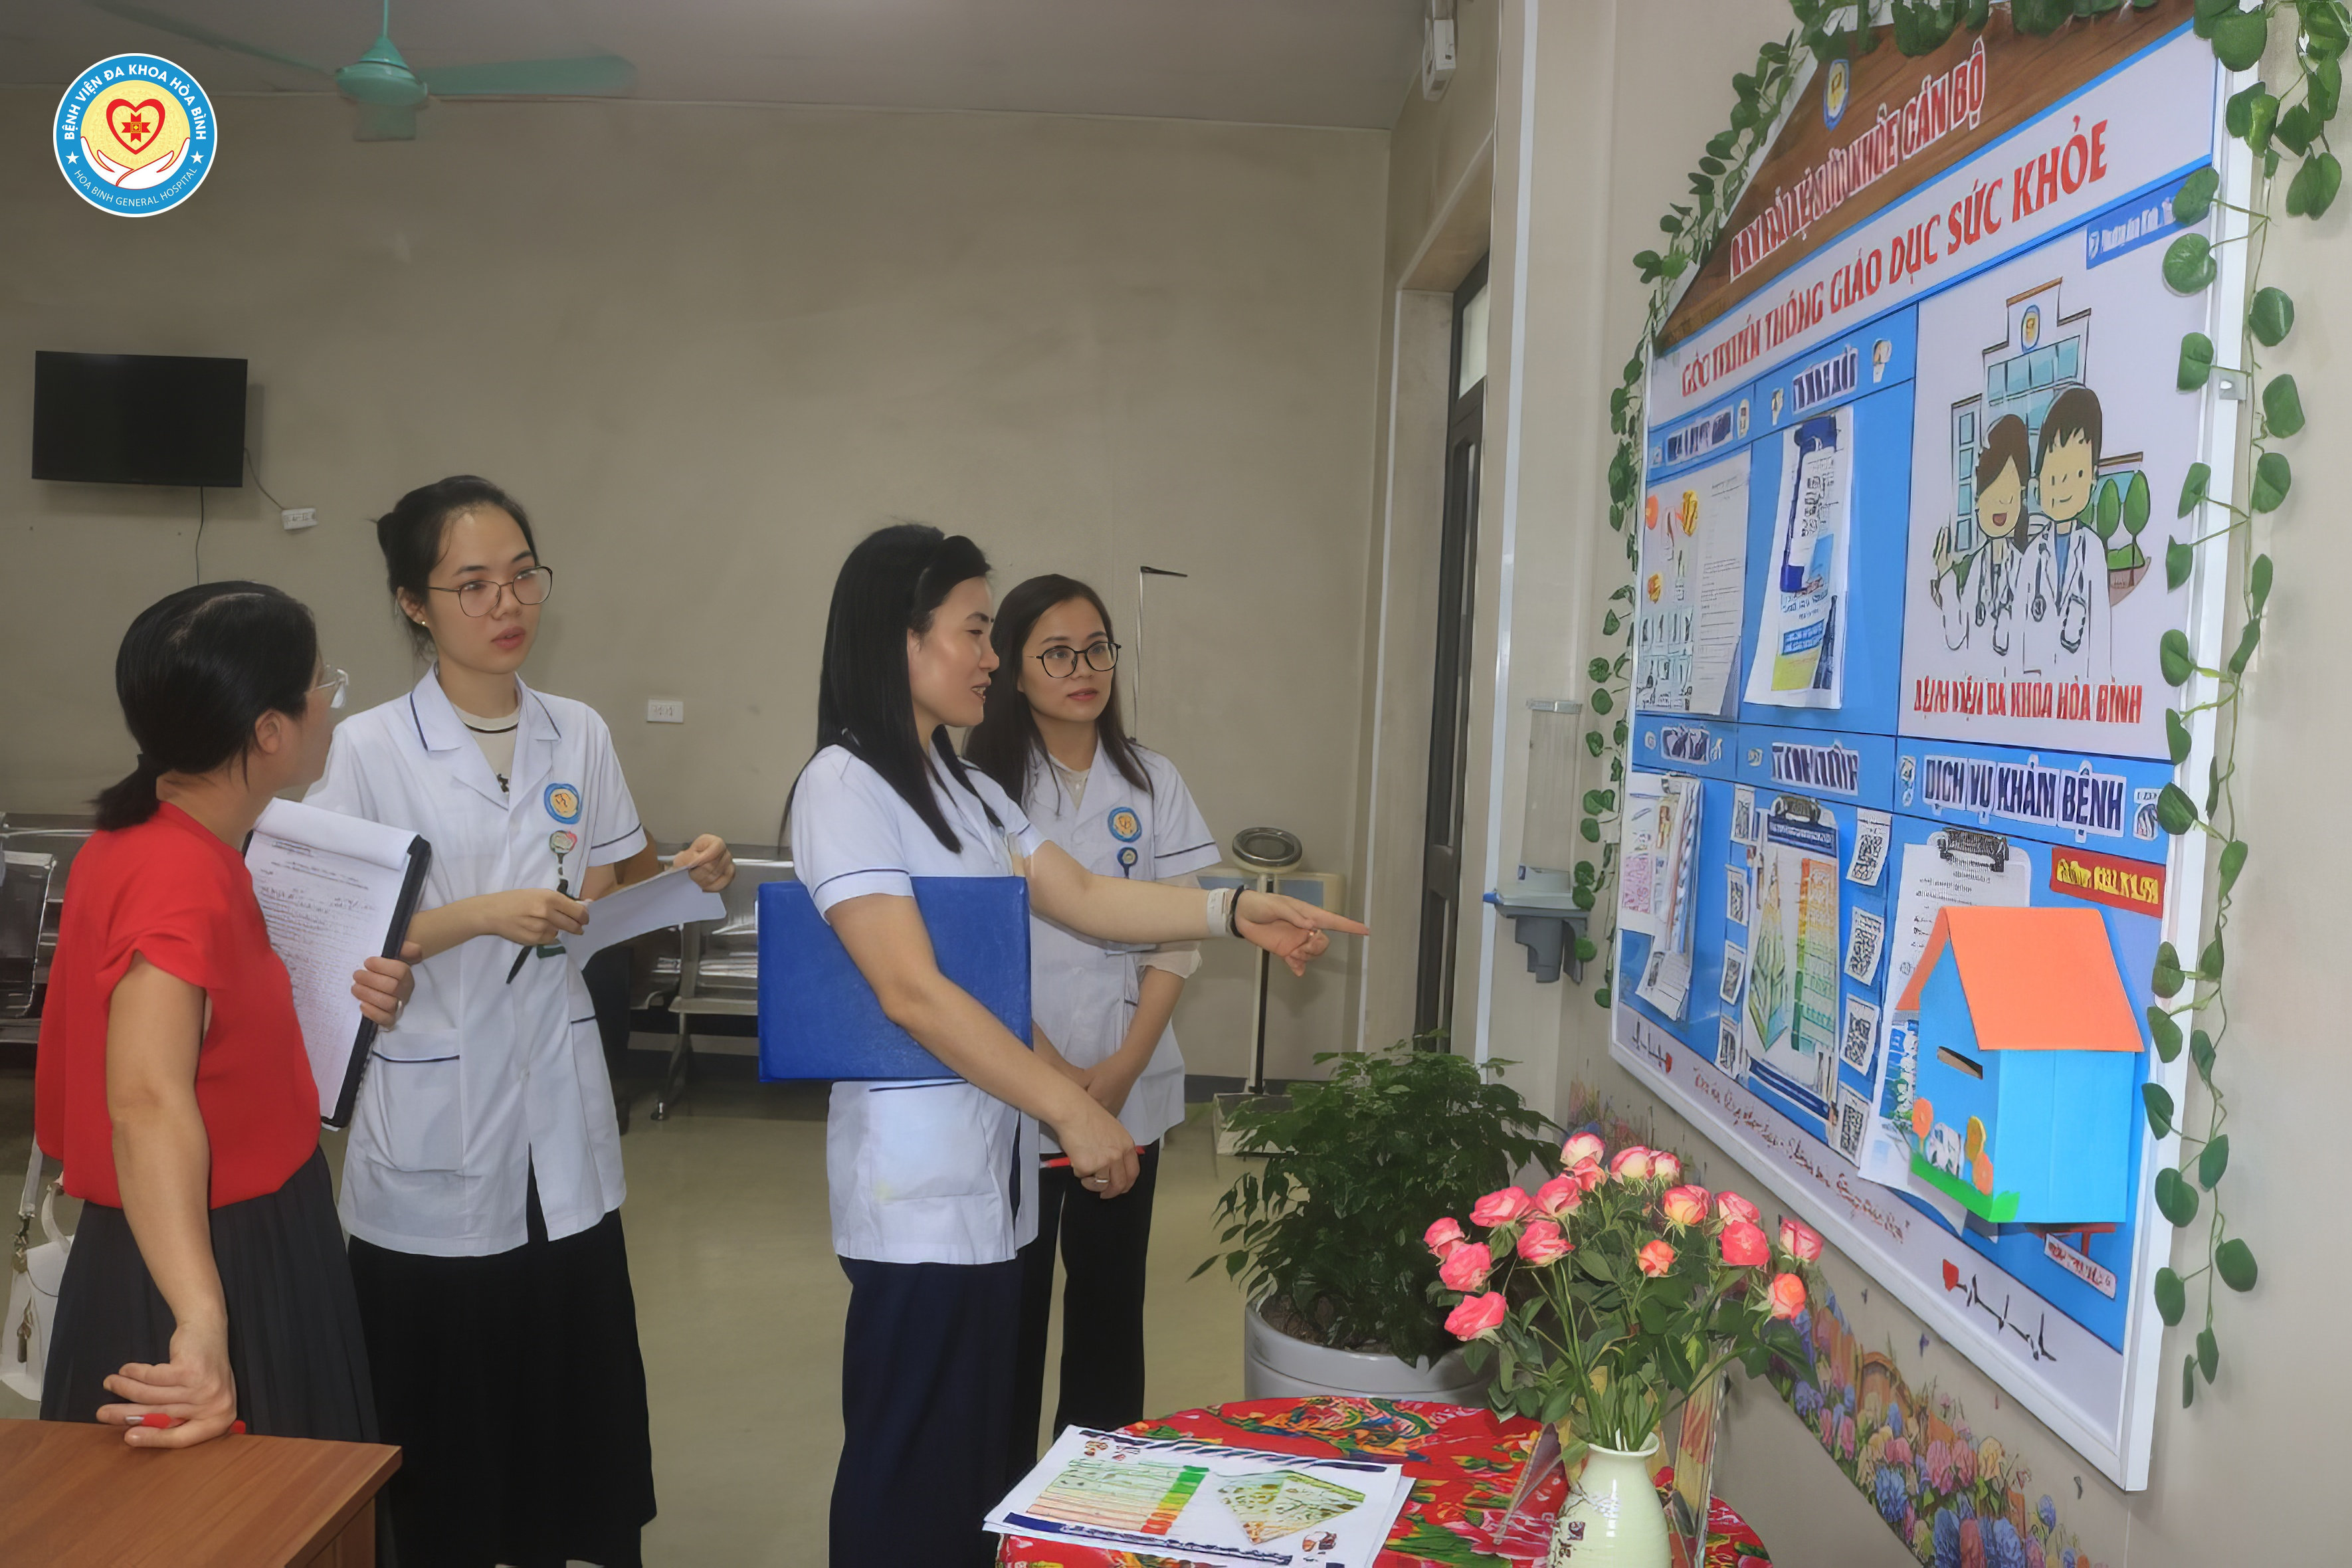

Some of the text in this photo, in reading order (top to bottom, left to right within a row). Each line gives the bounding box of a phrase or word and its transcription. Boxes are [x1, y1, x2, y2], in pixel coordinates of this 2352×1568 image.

[1888, 214, 1941, 285] DỤC
[1947, 178, 2003, 256] SỨC
[2012, 115, 2108, 223] KHỎE
[2062, 767, 2124, 836] BỆNH
